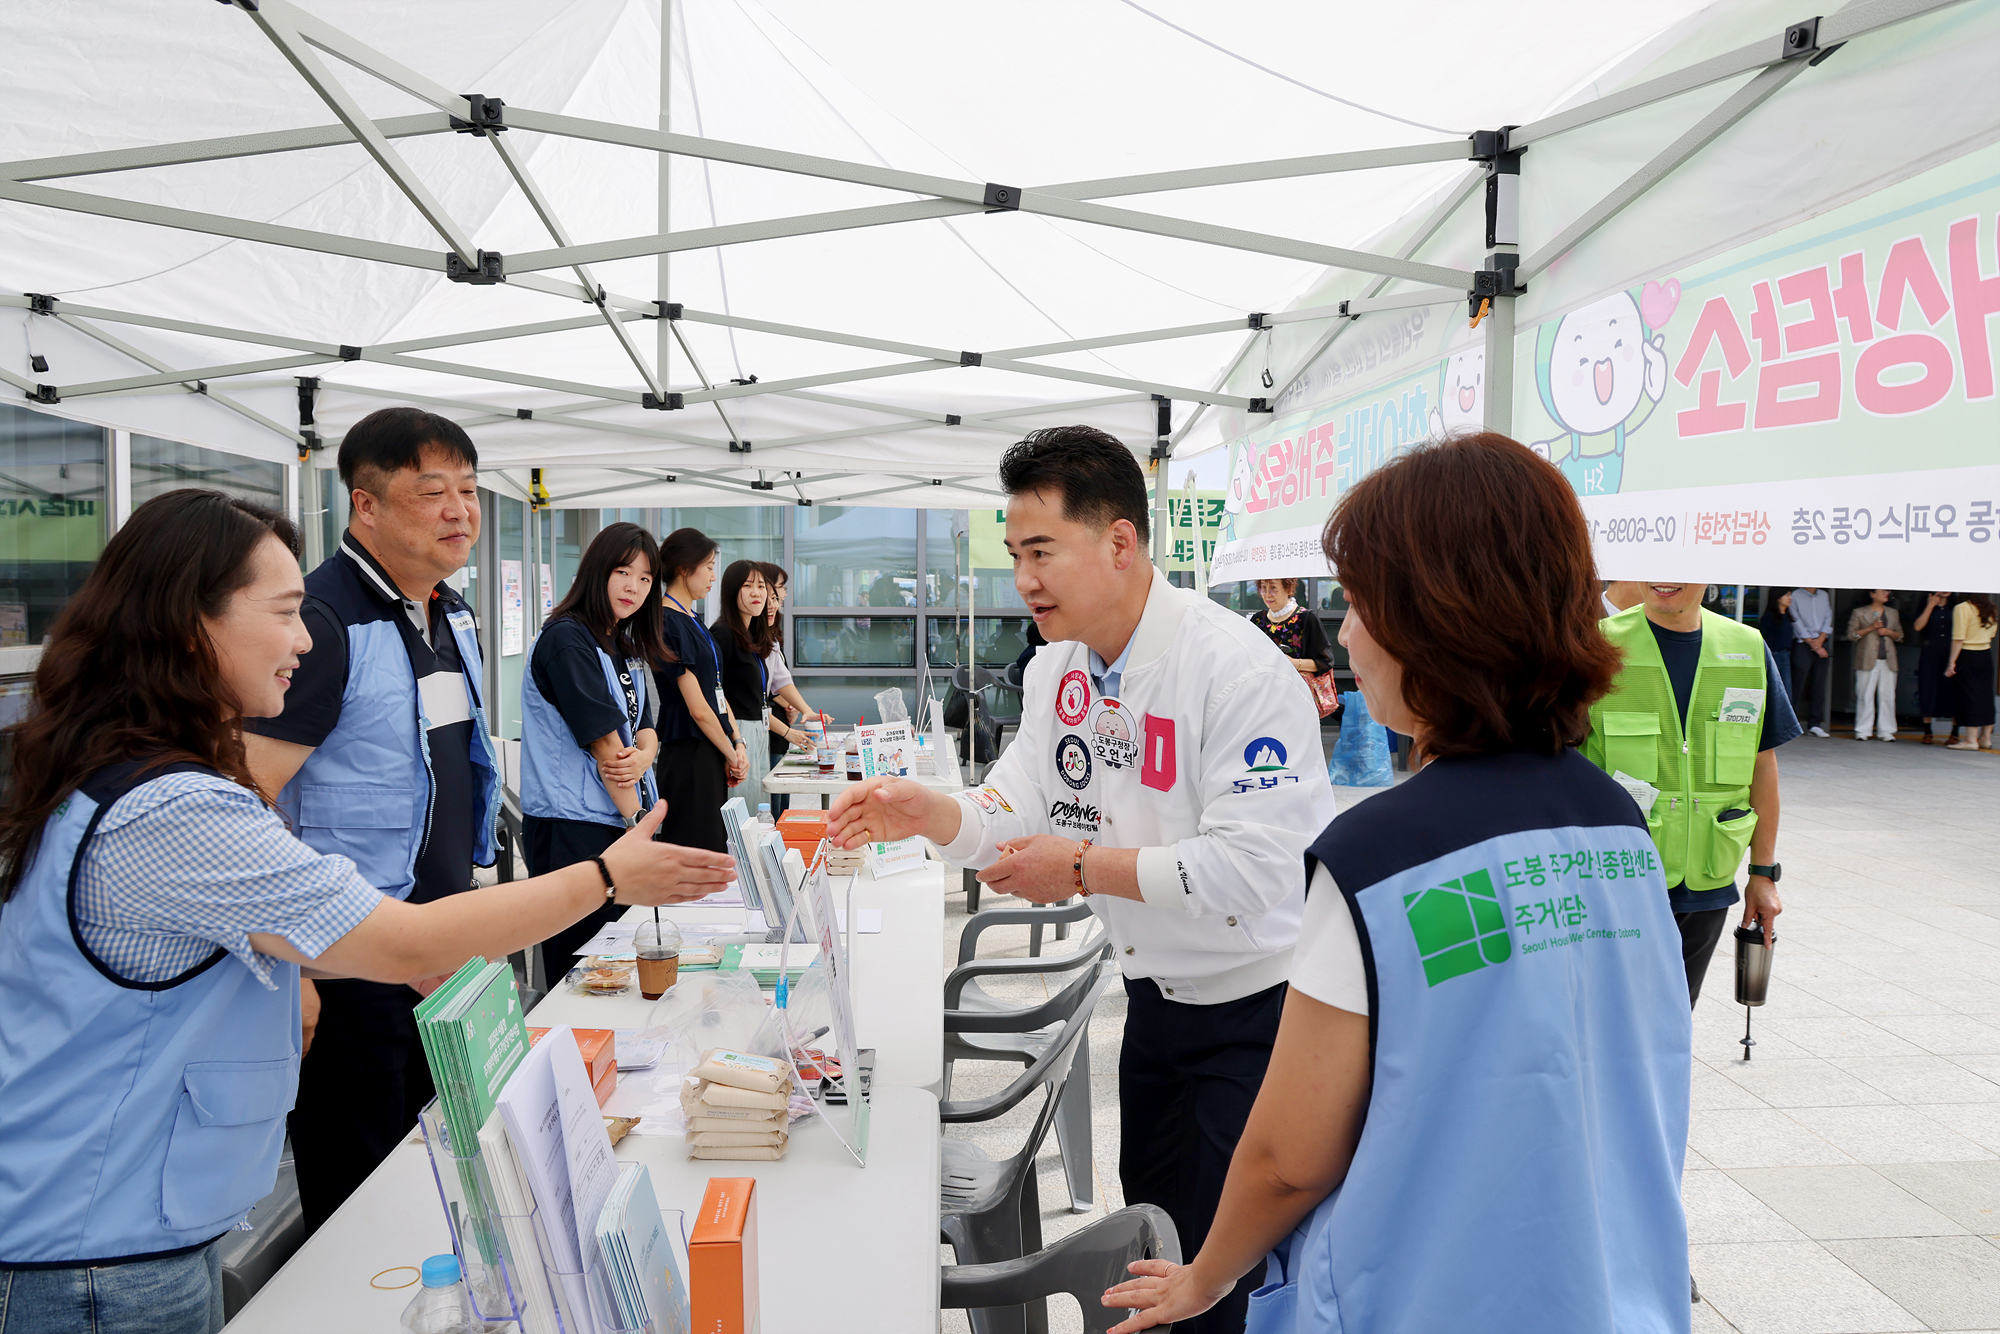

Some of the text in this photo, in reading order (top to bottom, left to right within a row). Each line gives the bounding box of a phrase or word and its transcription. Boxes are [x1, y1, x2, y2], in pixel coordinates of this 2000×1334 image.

[1065, 737, 1080, 746] SEOUL
[1098, 735, 1131, 751] 도봉구청장
[1141, 712, 1177, 793] D
[1060, 769, 1091, 789] DOBONG SOCKS
[1049, 801, 1098, 822] DOBONG
[1504, 854, 1546, 888] 도봉
[1522, 939, 1548, 954] Seoul
[1586, 928, 1617, 939] Center
[1618, 928, 1641, 939] Dobong
